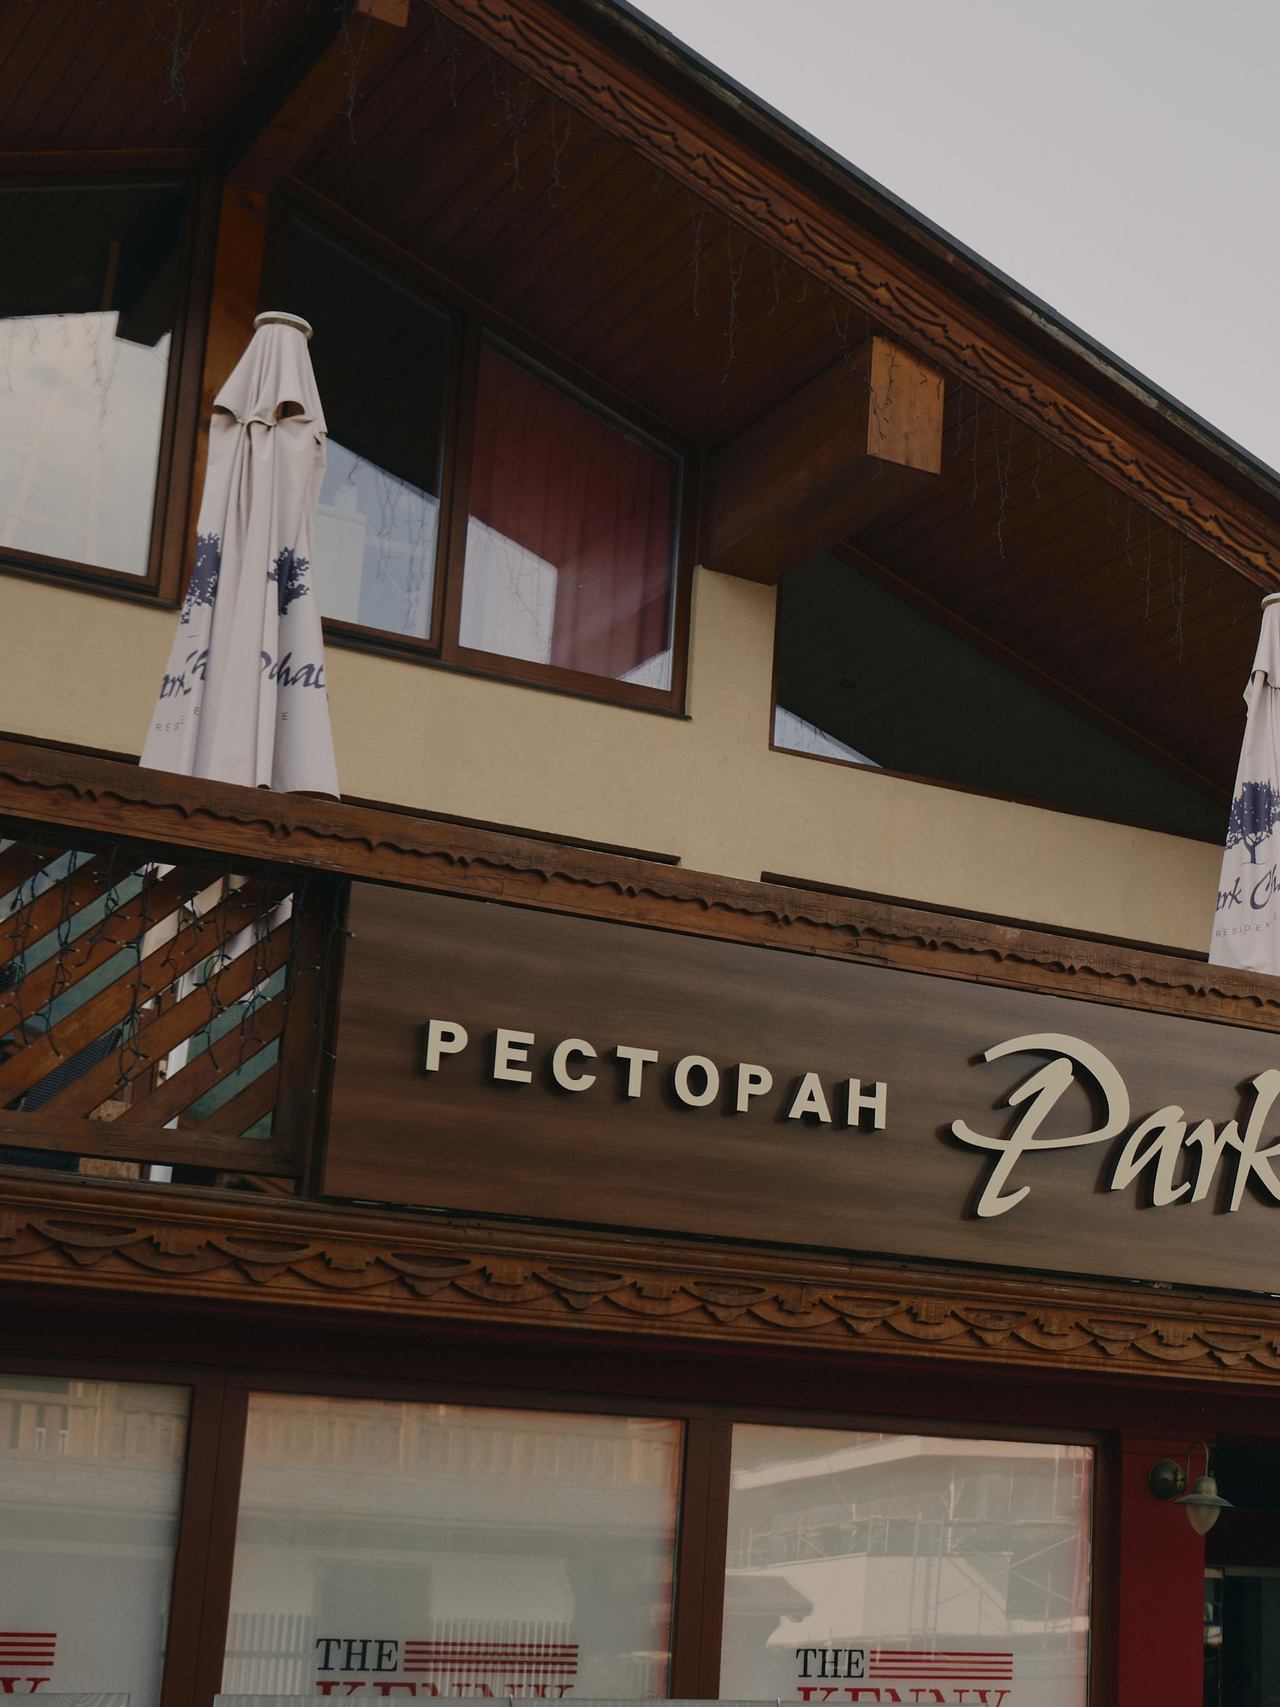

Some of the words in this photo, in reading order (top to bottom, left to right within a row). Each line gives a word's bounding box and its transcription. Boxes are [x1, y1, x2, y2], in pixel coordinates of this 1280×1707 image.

[1215, 912, 1278, 938] RESIDENE
[425, 1018, 888, 1131] РЕСТОРАН
[315, 1637, 399, 1672] THE
[796, 1648, 865, 1679] THE
